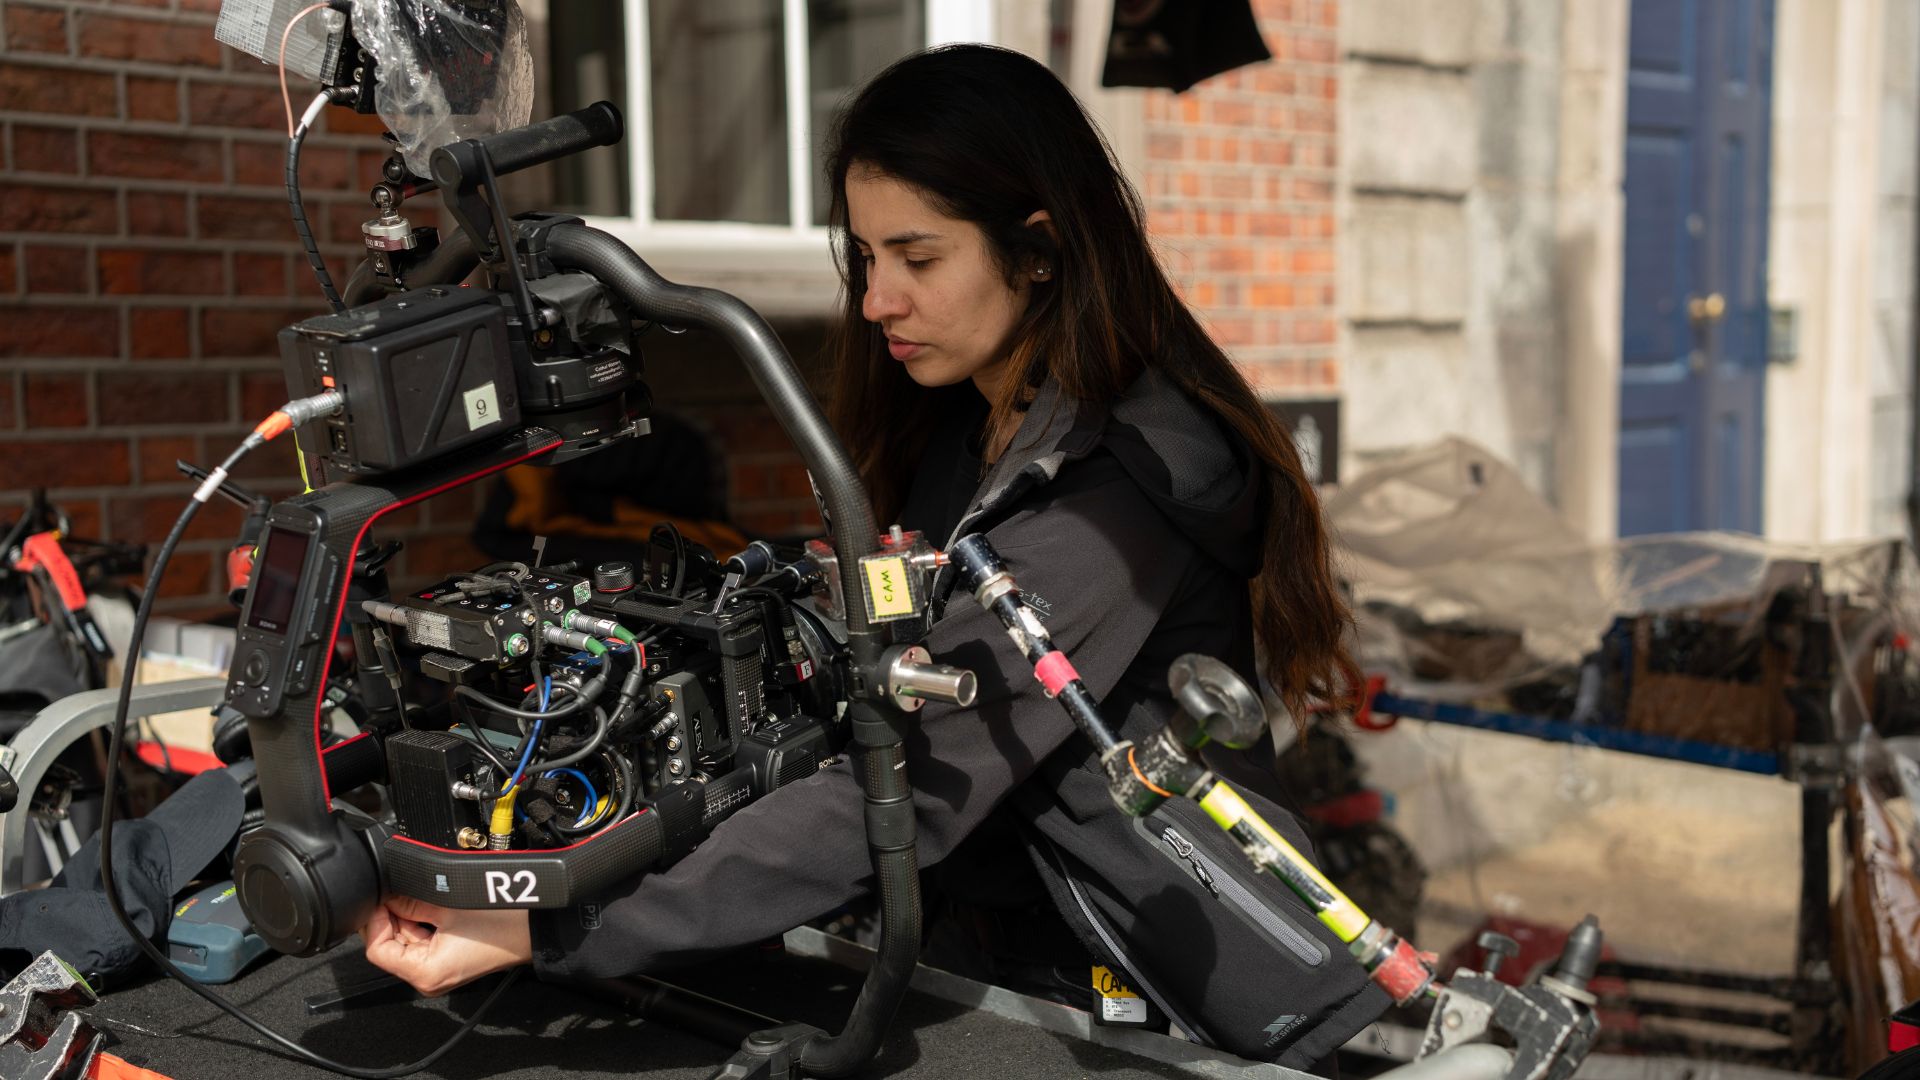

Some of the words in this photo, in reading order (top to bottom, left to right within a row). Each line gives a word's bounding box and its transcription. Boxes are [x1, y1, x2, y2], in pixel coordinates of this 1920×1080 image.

[476, 399, 487, 416] 9
[881, 570, 893, 602] CAM
[803, 664, 810, 676] F
[485, 870, 540, 904] R2
[1264, 1014, 1307, 1047] TRESPASS
